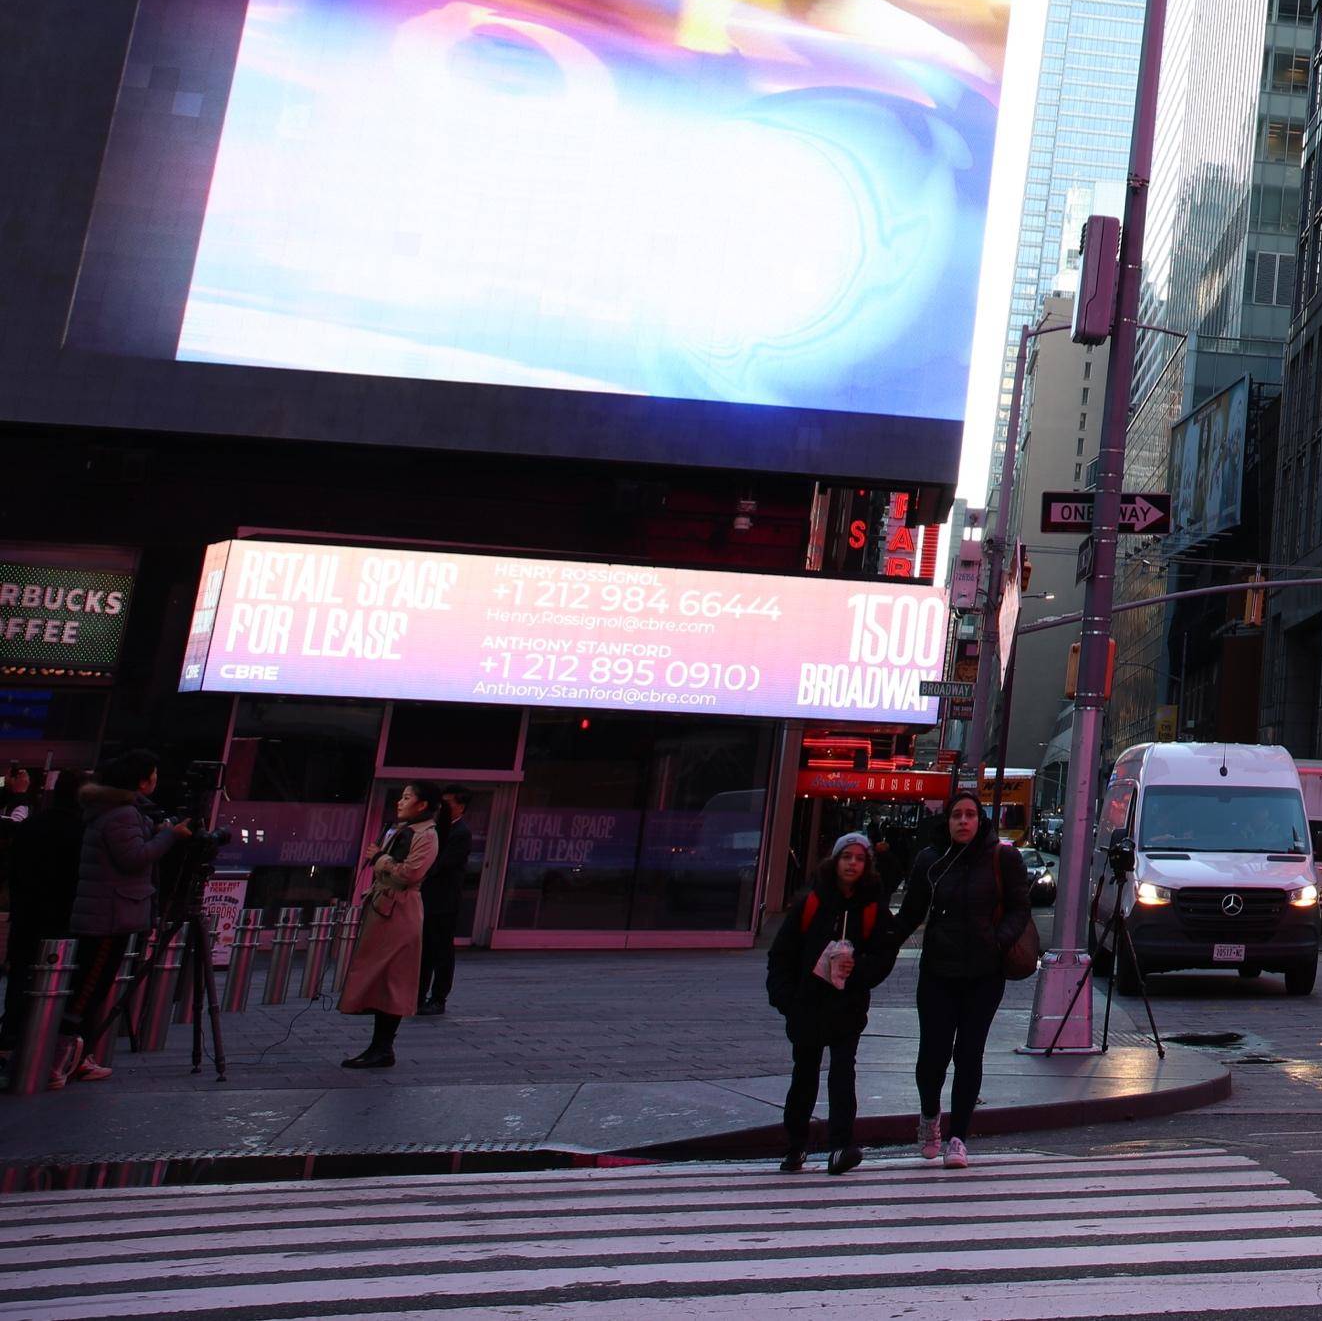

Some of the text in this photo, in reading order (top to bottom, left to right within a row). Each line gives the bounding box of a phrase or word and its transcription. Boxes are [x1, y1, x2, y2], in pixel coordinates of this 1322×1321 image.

[1060, 504, 1094, 521] ONE
[236, 549, 343, 603] RETAIL
[356, 556, 458, 610] SPACE
[494, 563, 662, 586] HENRY ROSSIGNOL
[491, 579, 525, 607] +1
[534, 581, 590, 610] 212
[600, 584, 669, 614] 984
[224, 603, 409, 660] FOR LEASE
[486, 608, 715, 635] Henry.Rossignol@cbre.com
[847, 594, 944, 668] 1500
[481, 635, 671, 659] ANTHONY STANFORD
[220, 664, 279, 681] CBRE
[480, 652, 511, 679] +1
[521, 653, 579, 683] 212
[589, 657, 655, 687] 895
[472, 680, 717, 706] Anthony.Stanford@cbre.com
[921, 682, 970, 697] BROADWAY
[867, 777, 924, 792] DINER
